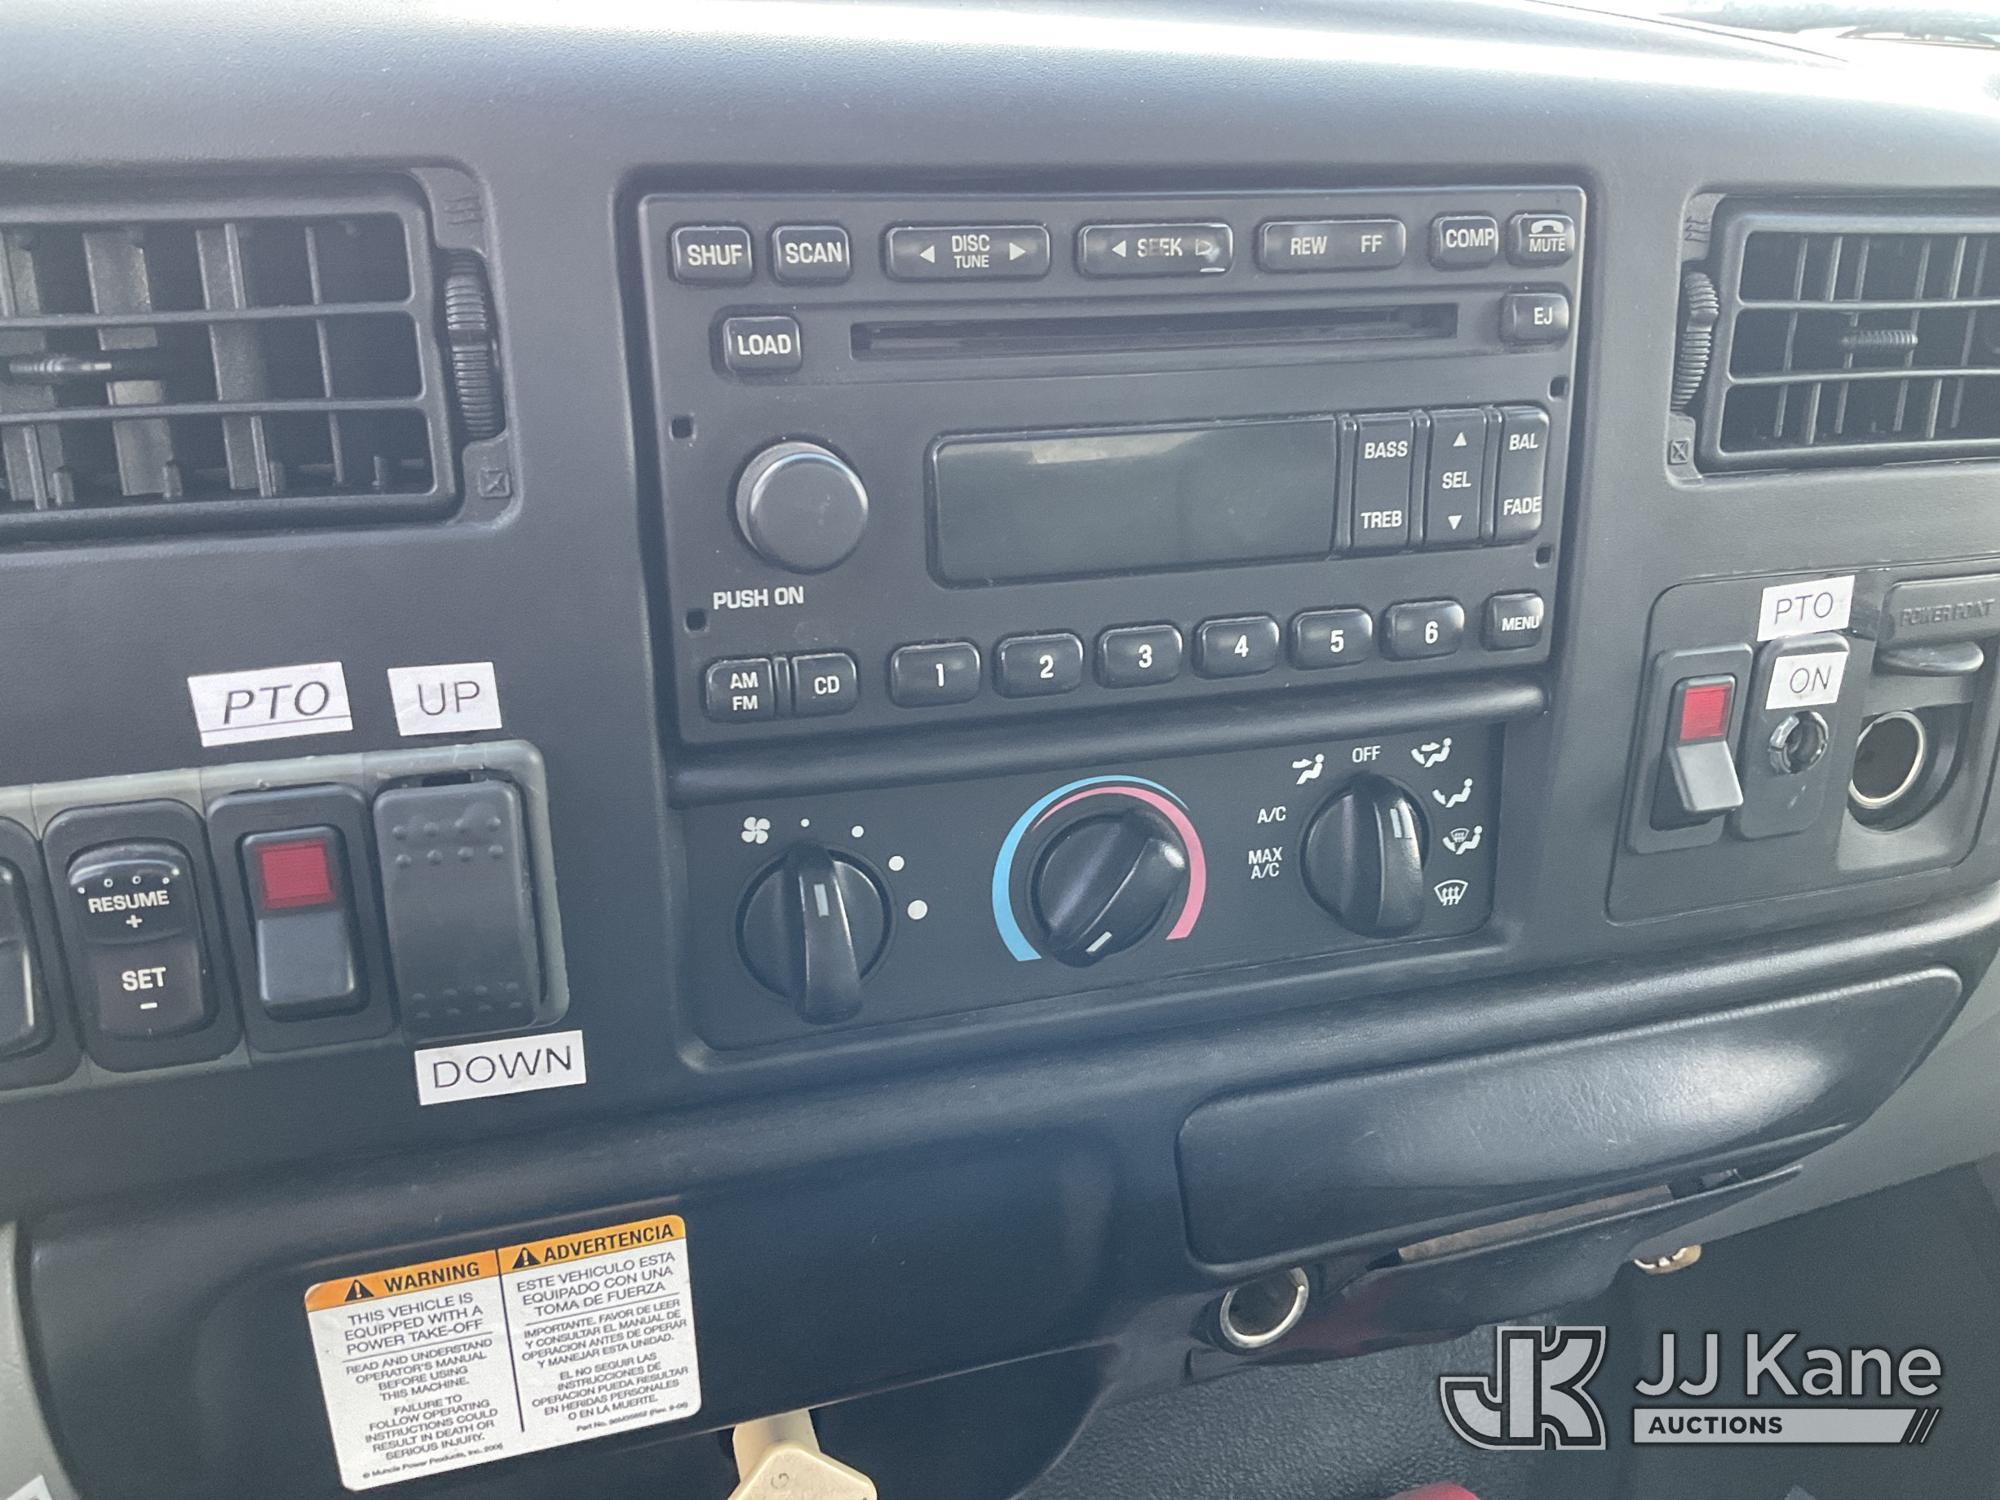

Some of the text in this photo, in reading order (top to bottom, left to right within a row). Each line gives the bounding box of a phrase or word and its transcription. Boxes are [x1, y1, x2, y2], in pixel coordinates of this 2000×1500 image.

[951, 234, 991, 253] DISC
[1136, 238, 1183, 258] SEEK
[1290, 234, 1383, 256] REW FF
[1445, 228, 1495, 249] COMP
[1529, 236, 1566, 253] MUTE
[687, 243, 743, 266] SHUF
[785, 241, 843, 264] SCAN
[953, 254, 990, 269] TUNE
[1533, 306, 1554, 326] EJ
[737, 333, 792, 357] LOAD
[1364, 441, 1409, 459] BASS
[1508, 433, 1539, 451] BAL
[1441, 471, 1472, 489] SEL
[1502, 495, 1542, 516] FADE
[1360, 510, 1403, 529] TREB
[712, 585, 805, 611] PUSH ON
[1773, 591, 1834, 625] PTO
[1501, 615, 1541, 632] MENU
[1900, 598, 1996, 627] POWER POINT
[1329, 628, 1345, 653] 5
[1424, 620, 1439, 644] 6
[1137, 643, 1153, 668] 3
[1234, 634, 1249, 659] 4
[934, 662, 946, 688] 1
[1039, 654, 1054, 679] 2
[729, 671, 759, 690] AM
[814, 674, 840, 695] CD
[1789, 666, 1832, 694] ON
[222, 680, 331, 726] PTO
[416, 678, 481, 716] UP
[732, 695, 758, 711] FM
[1352, 745, 1381, 764] OFF
[1257, 805, 1287, 824] A/C
[1248, 846, 1284, 865] MAX
[1250, 861, 1280, 880] A/C
[88, 889, 170, 914] RESUME
[121, 966, 167, 992] SET
[432, 1044, 573, 1089] DOWN
[543, 1223, 674, 1262] ADVERTENCIA
[383, 1261, 479, 1292] WARNING
[516, 1251, 675, 1292] ESTE VEHICULO ESTA
[522, 1265, 673, 1306] EQUIPADO CON UNA
[346, 1291, 473, 1326] THIS VEHICLE IS
[533, 1281, 666, 1316] TOMA DE FUERZA
[598, 1308, 634, 1323] FAVOR
[635, 1304, 650, 1315] DE
[652, 1298, 680, 1311] LEER
[343, 1304, 483, 1341] EQUIPPED WITH A
[524, 1308, 681, 1349] Y CONSULTAR EL MANUAL DE
[346, 1317, 482, 1355] POWER TAKE-OFF
[521, 1318, 687, 1361] OPERACION ANTES DE OPERAR
[345, 1338, 492, 1375] READ AND UNDERSTAND
[435, 1350, 487, 1368] MANUAL
[536, 1332, 674, 1368] Y MANEJAR ESTA UNIDAD.
[377, 1365, 468, 1390] BEFORE USING
[556, 1360, 661, 1391] INSTRUCCIONES DE
[559, 1351, 657, 1380] EL NO SEGUIR LAS
[378, 1388, 408, 1401] THIS
[531, 1365, 688, 1407] OPERACION PUEDA RESULTAR
[543, 1378, 679, 1416] EN HERIDAS PERSONALES
[368, 1398, 490, 1431] FOLLOW OPERATING
[393, 1393, 462, 1415] FAILURE TO
[567, 1411, 577, 1420] O
[578, 1407, 594, 1418] EN
[596, 1404, 610, 1414] LA
[364, 1407, 498, 1443] INSTRUCTIONS COULD
[371, 1419, 494, 1452] RESULT IN DEATH OR
[385, 1431, 485, 1460] SERIOUS INJURY.
